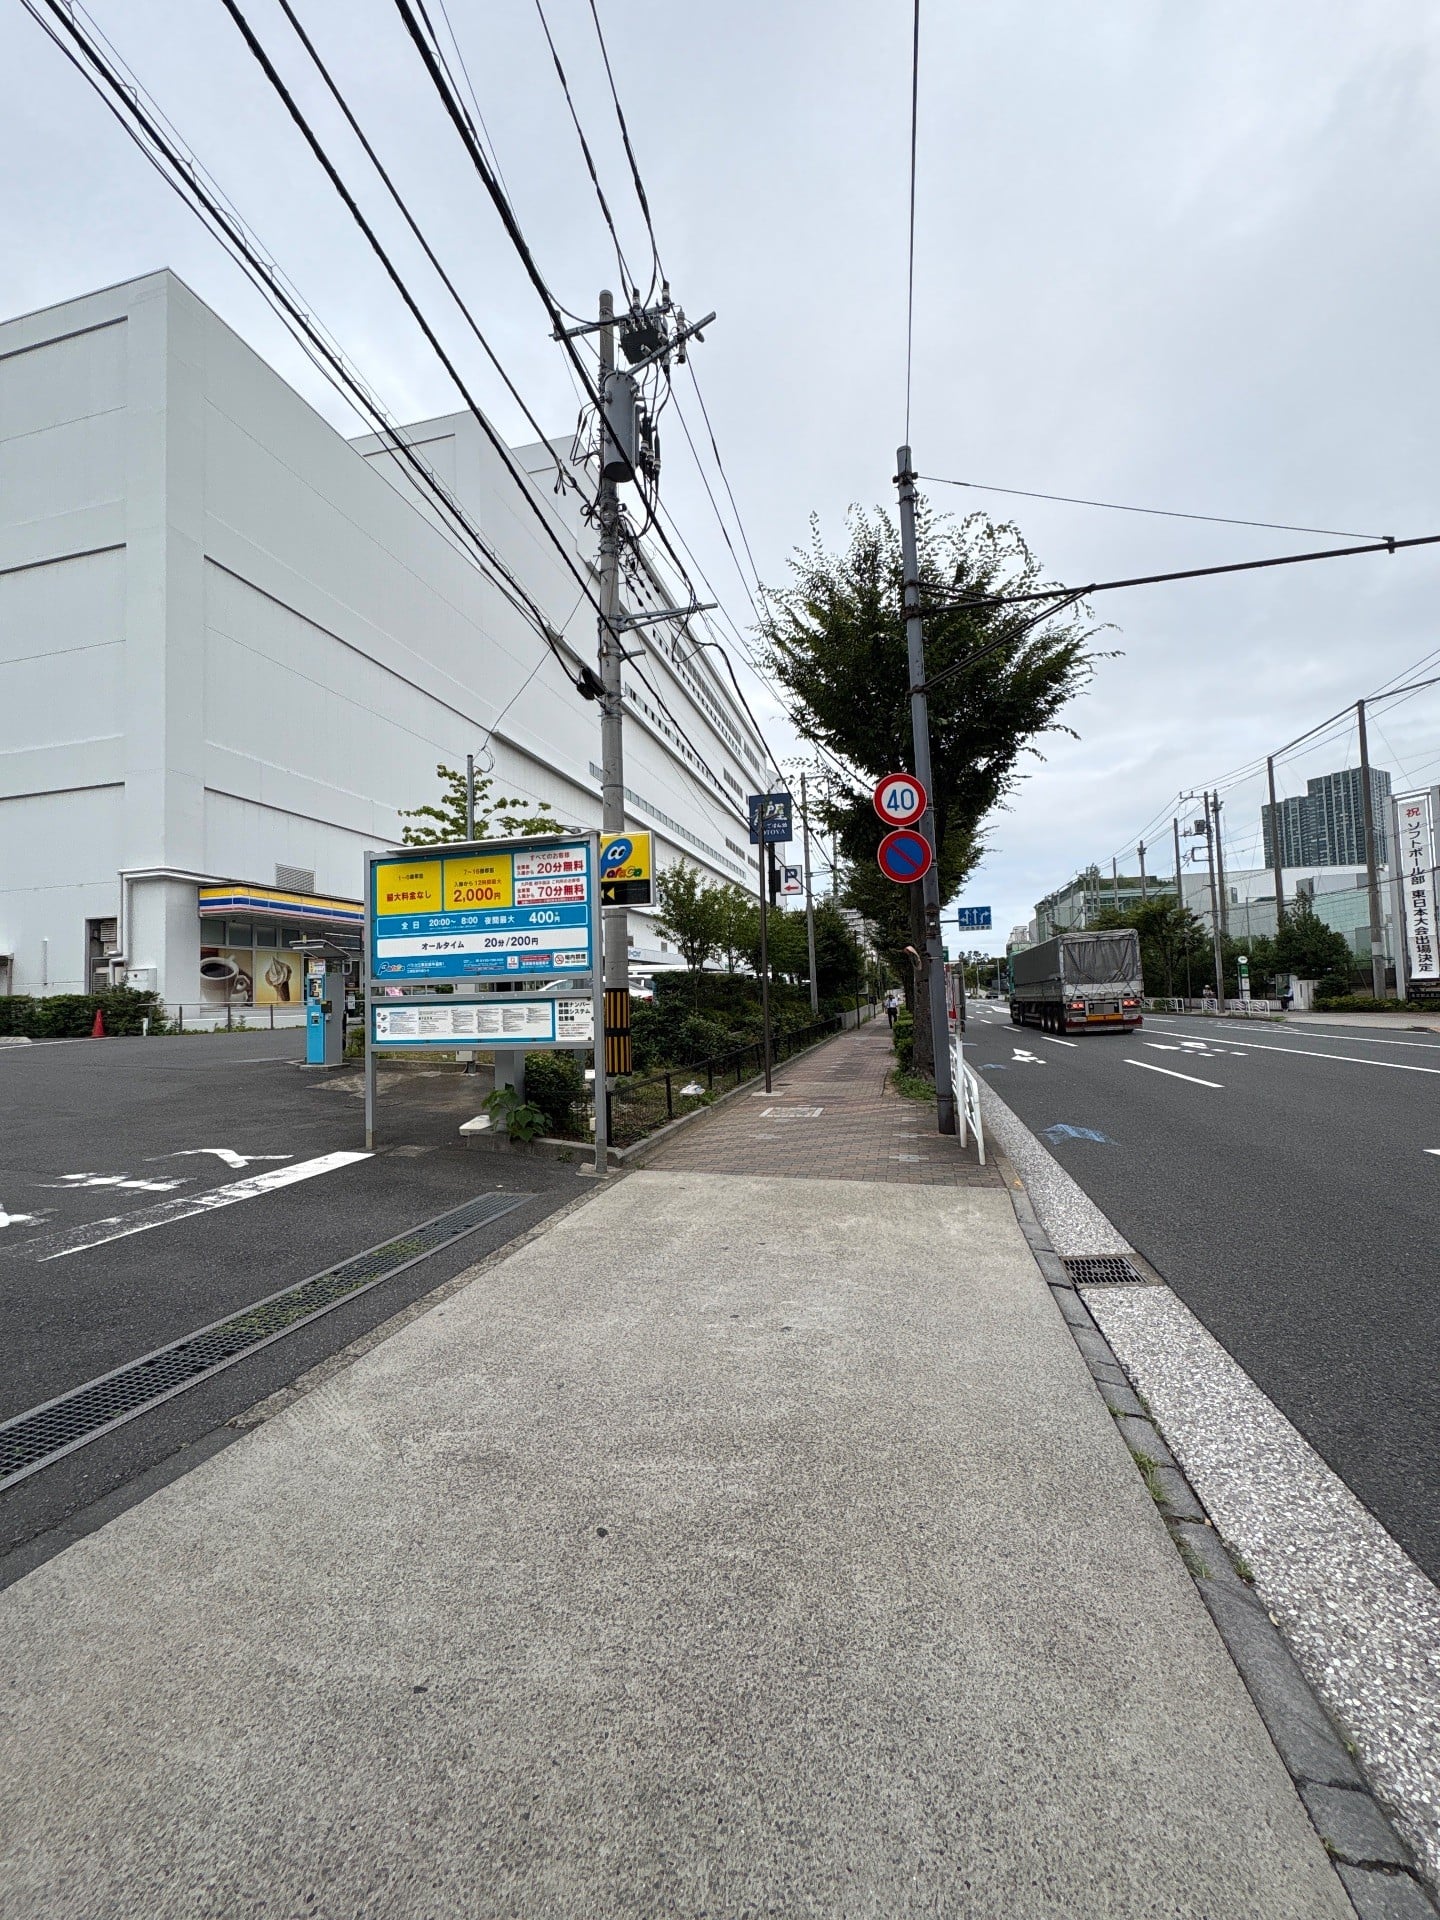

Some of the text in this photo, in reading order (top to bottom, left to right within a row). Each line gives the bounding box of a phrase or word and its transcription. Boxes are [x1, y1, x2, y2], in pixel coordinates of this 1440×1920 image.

[887, 788, 915, 812] 40
[1406, 807, 1421, 818] 祝
[1408, 821, 1426, 885] ソフトボール部
[537, 860, 584, 874] 20分無料
[784, 868, 798, 883] P
[453, 887, 501, 903] 2,000円
[537, 884, 584, 897] 70分無料
[460, 916, 478, 925] 8:00
[528, 911, 560, 924] 400円
[1411, 889, 1433, 973] 東日本大会出場決定
[421, 941, 465, 951] オールタイム
